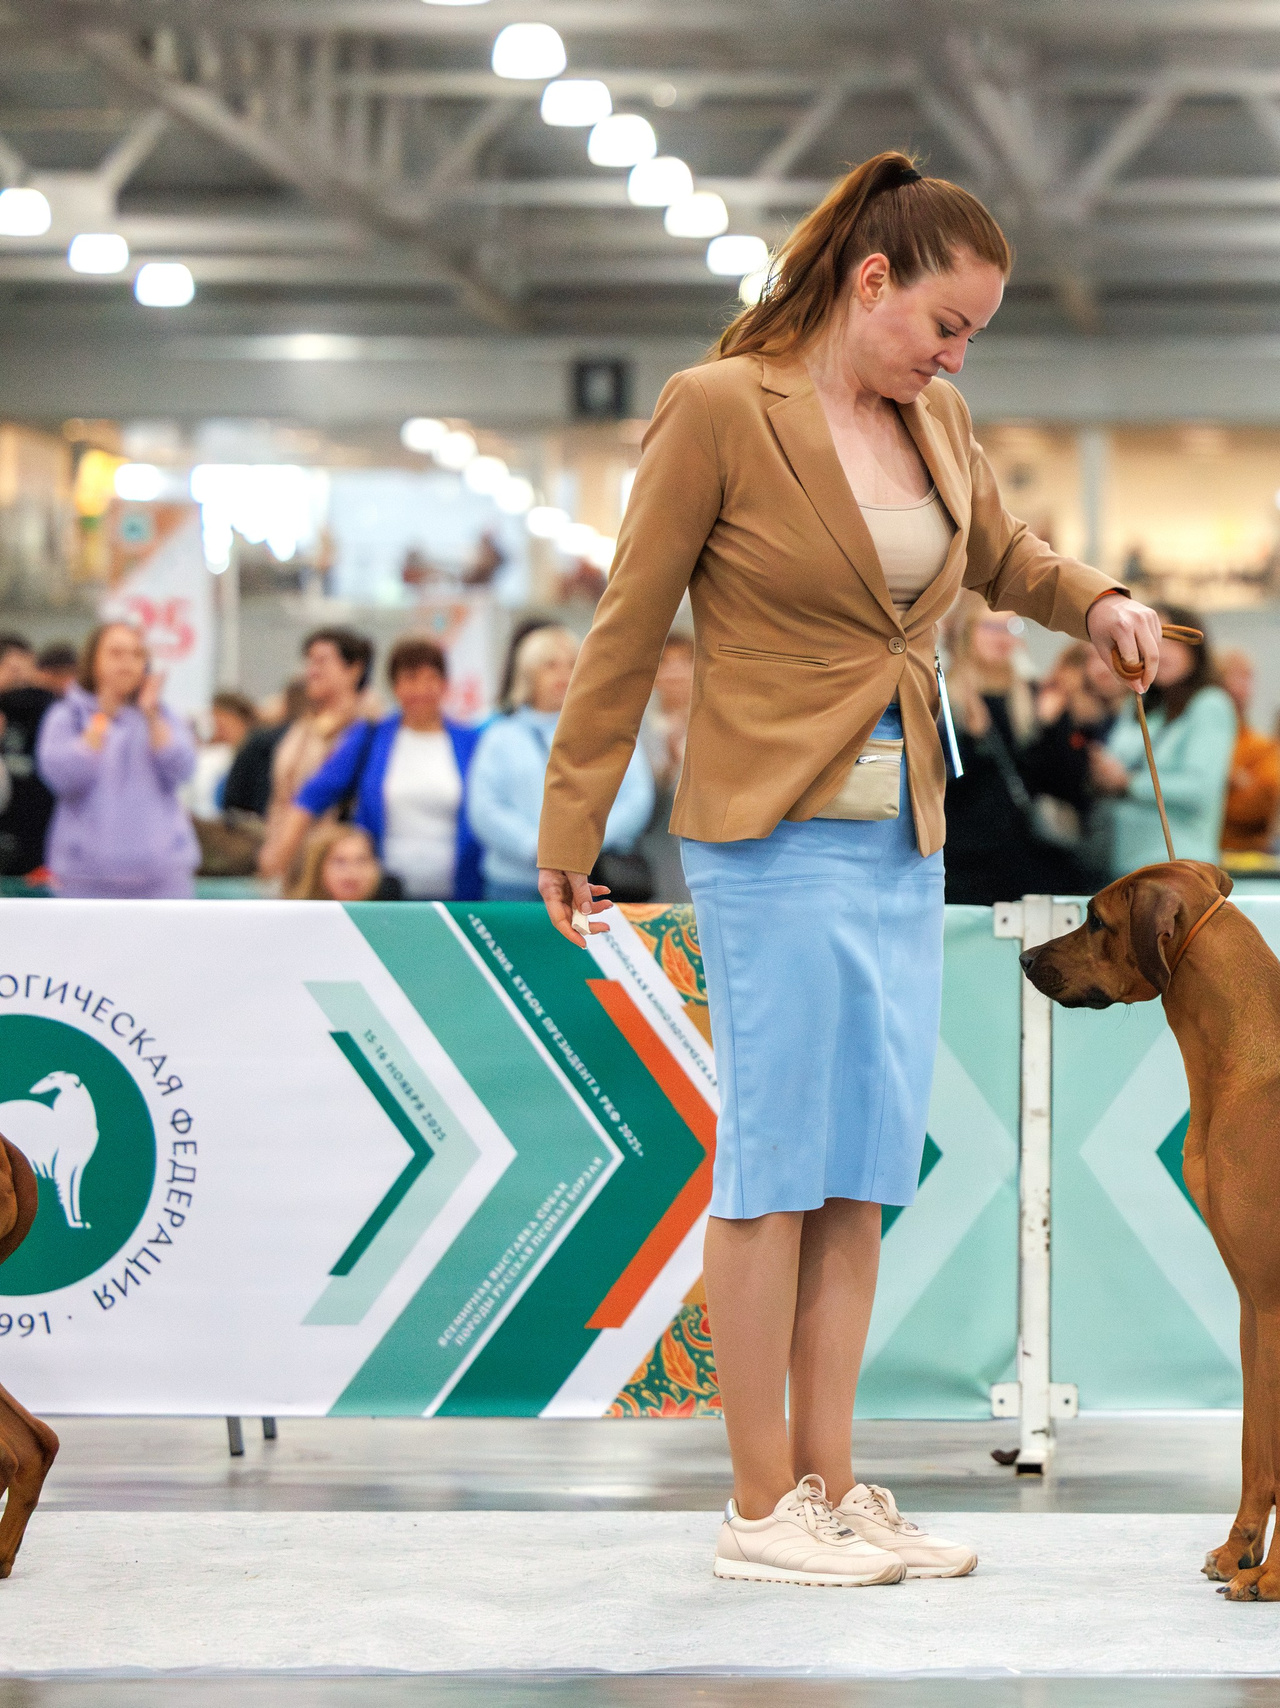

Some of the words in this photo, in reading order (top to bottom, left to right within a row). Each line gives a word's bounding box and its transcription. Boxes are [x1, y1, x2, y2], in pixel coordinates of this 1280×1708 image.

[0, 973, 184, 1096] ОГИЧЕСКАЯ
[92, 1108, 198, 1311] ФЕДЕРАЦИЯ
[512, 975, 545, 1017] КУБОК
[542, 1016, 601, 1096] ПРЕЗИДЕНТА
